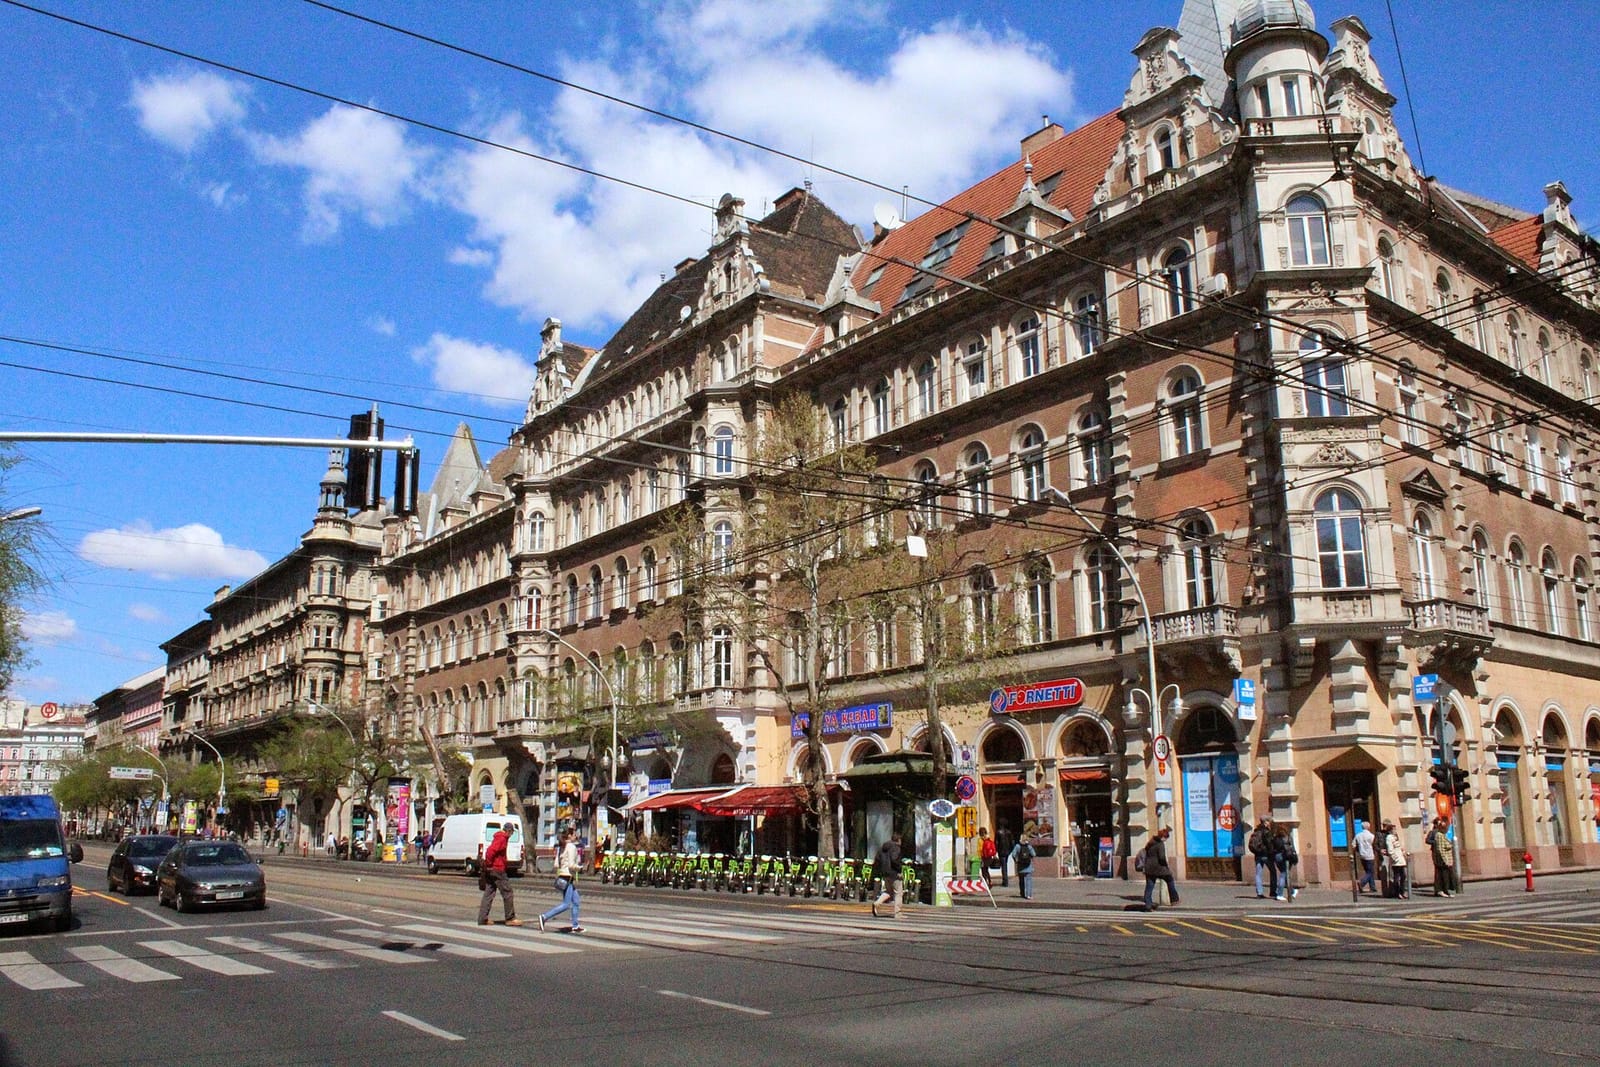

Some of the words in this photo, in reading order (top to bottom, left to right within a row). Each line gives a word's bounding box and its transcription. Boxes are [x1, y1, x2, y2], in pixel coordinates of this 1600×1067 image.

[1008, 684, 1076, 706] FORNETTI
[841, 709, 877, 724] KEBAB
[1157, 743, 1166, 754] 30
